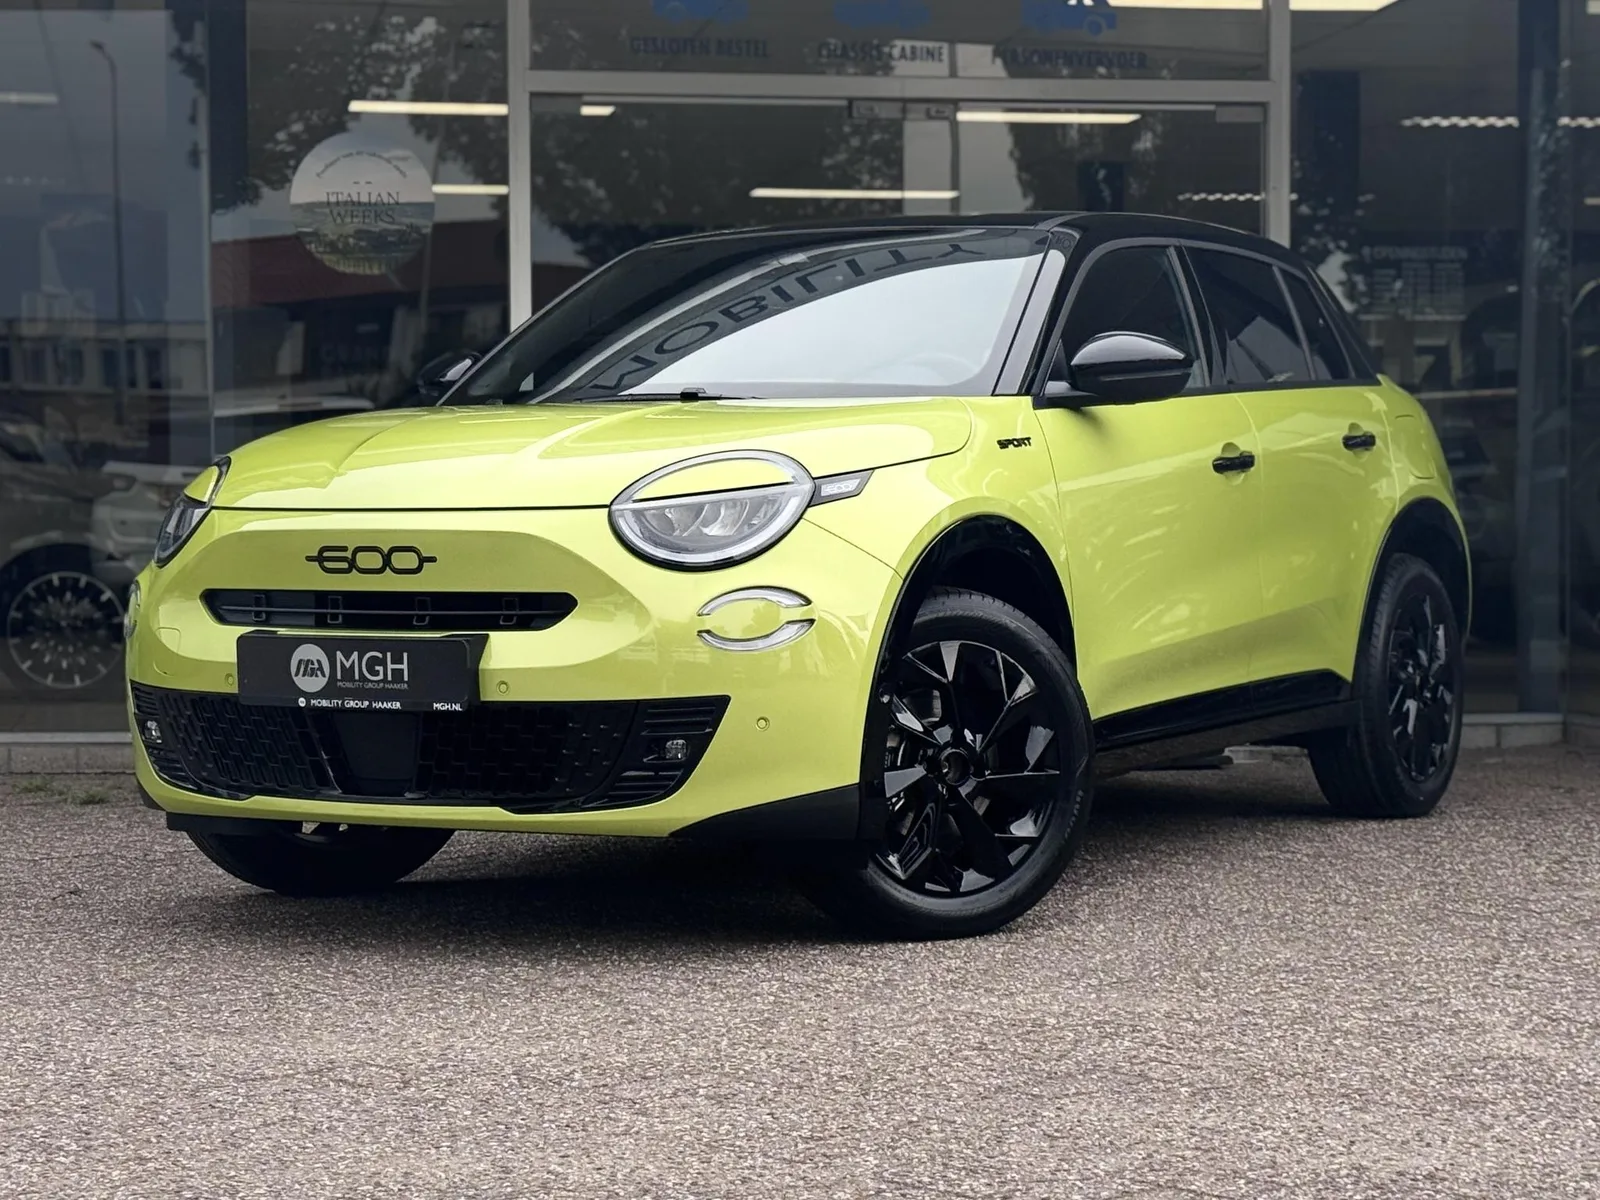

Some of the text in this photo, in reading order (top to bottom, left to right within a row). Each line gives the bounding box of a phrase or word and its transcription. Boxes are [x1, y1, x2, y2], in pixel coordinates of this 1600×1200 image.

[714, 39, 768, 58] BESTEL
[325, 191, 400, 206] ITALIAN
[329, 209, 396, 225] WEEKS
[996, 436, 1032, 450] SPORT
[311, 545, 431, 575] 600
[336, 650, 408, 682] MGH
[337, 681, 362, 689] MOBILITY
[363, 682, 384, 690] GROUP
[310, 698, 402, 710] MOBILITY GROUP HAAKER
[432, 702, 463, 711] MGH.NL
